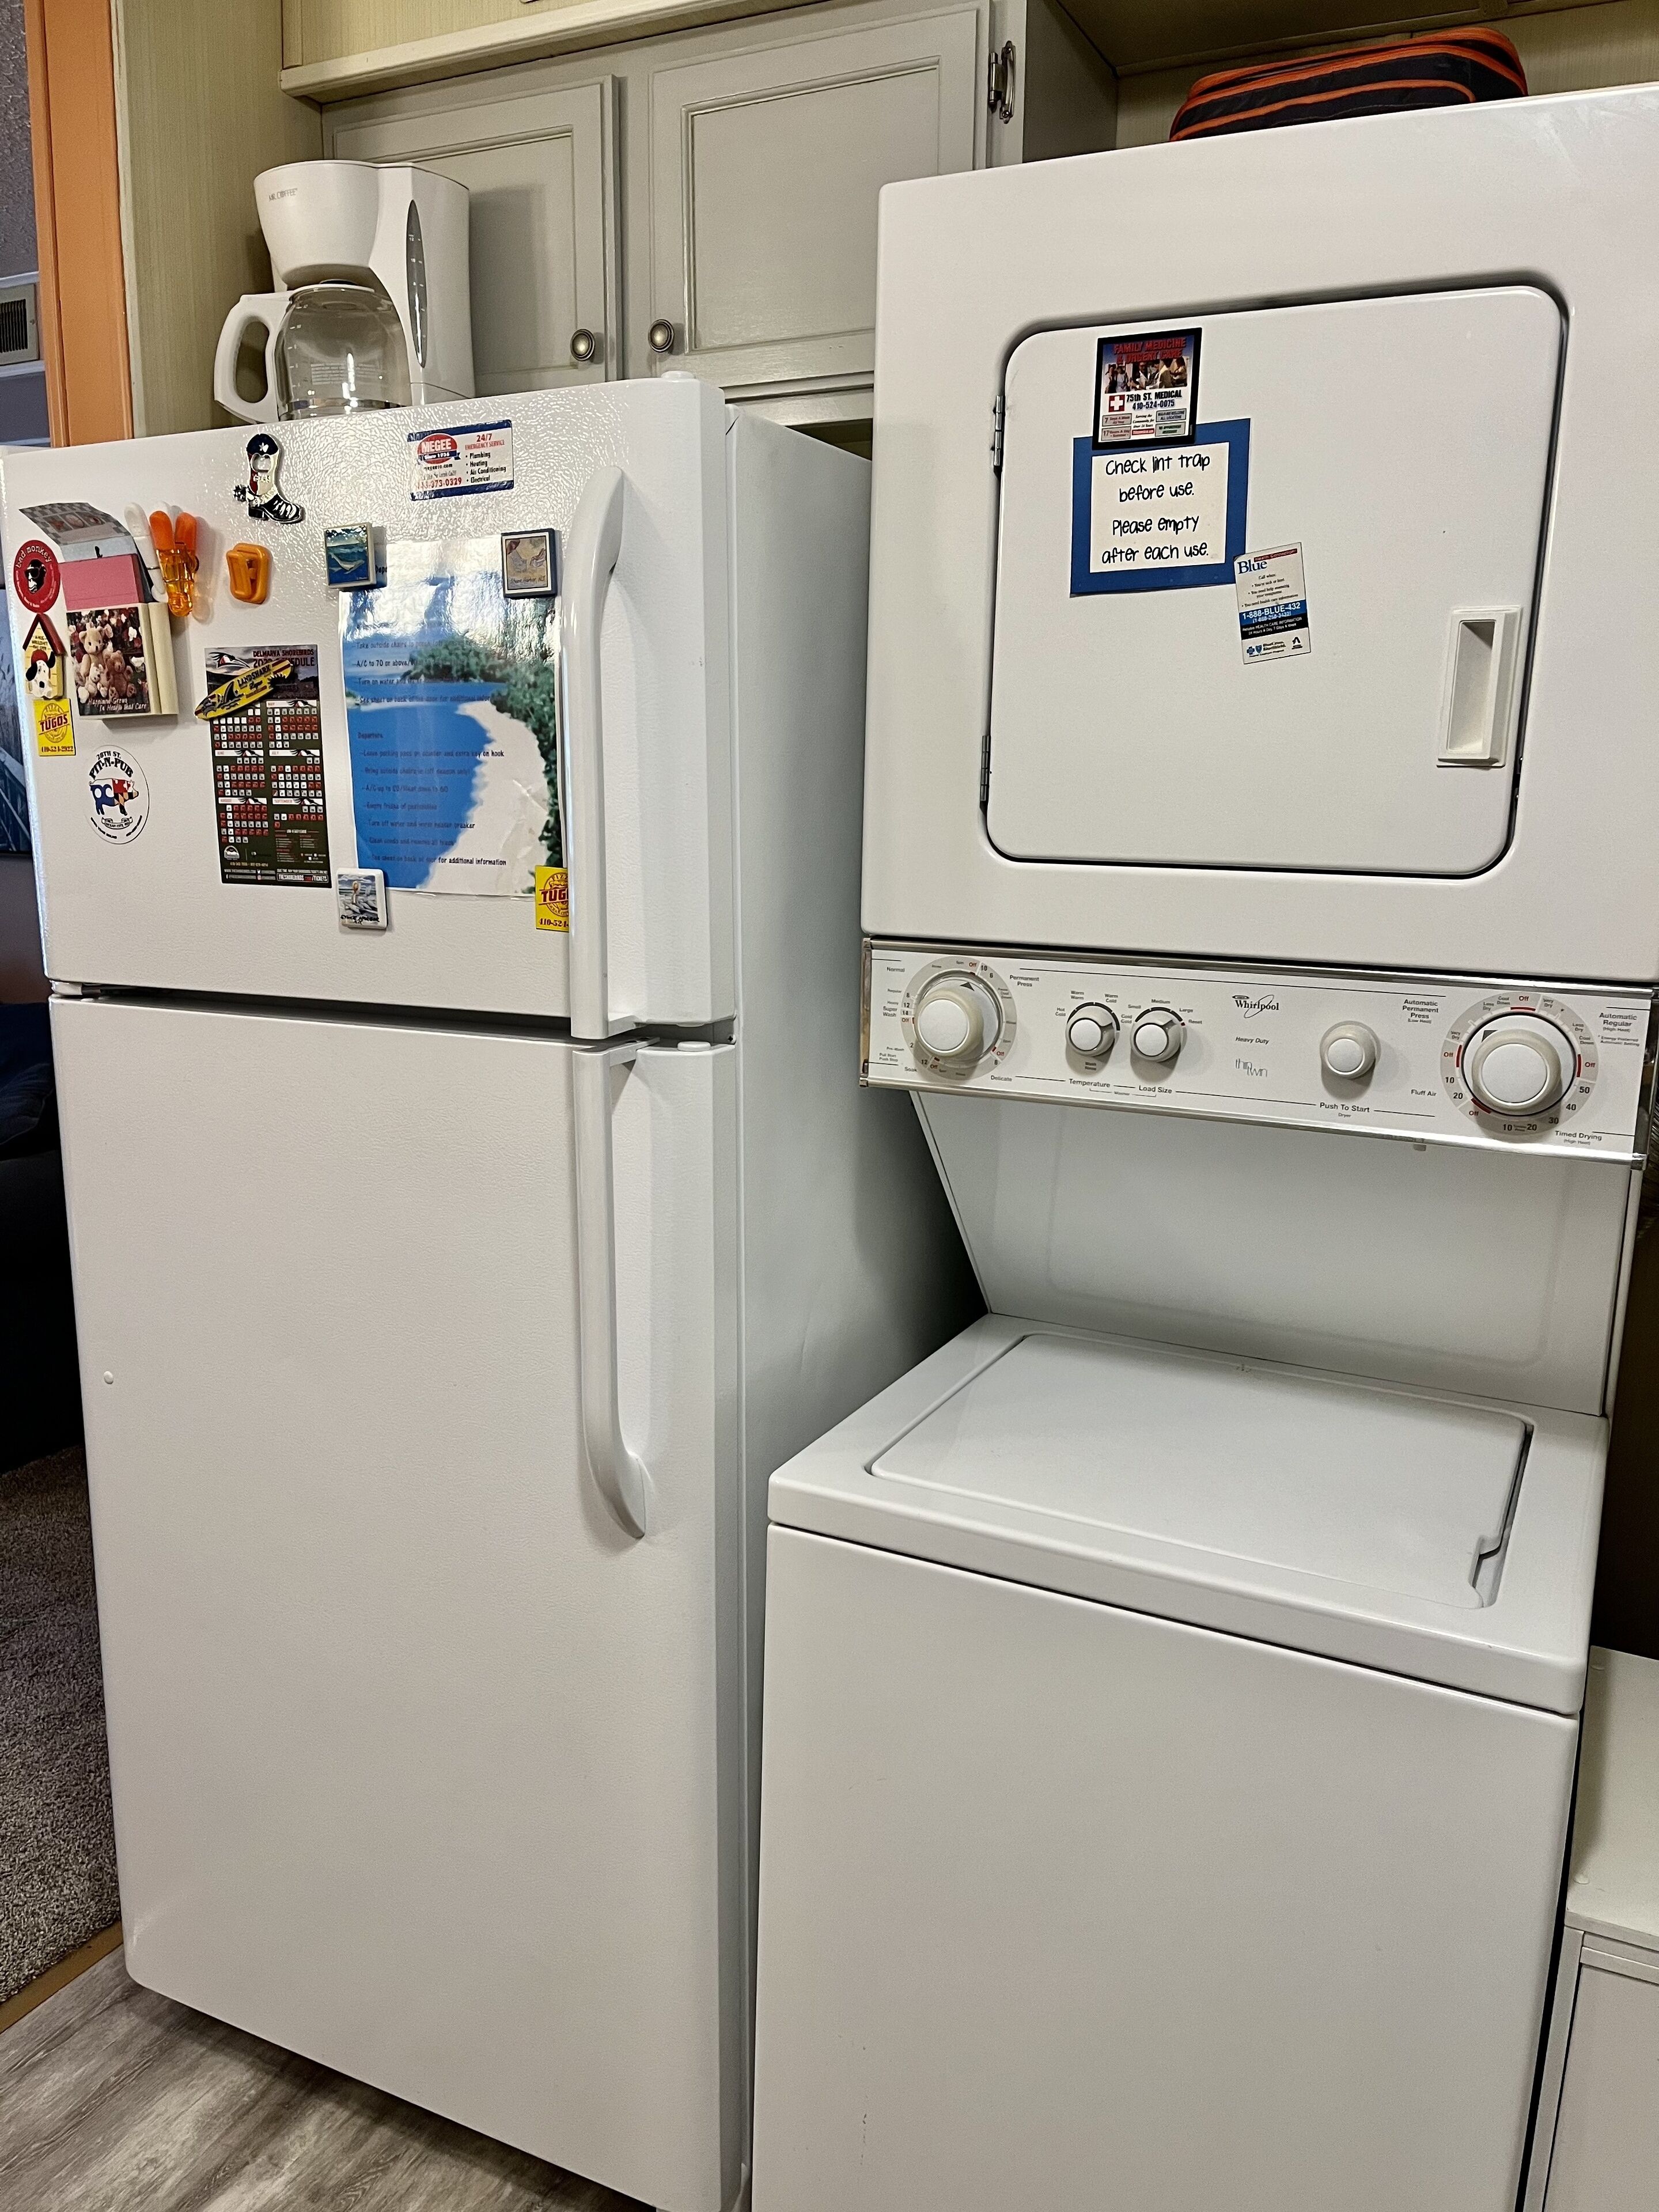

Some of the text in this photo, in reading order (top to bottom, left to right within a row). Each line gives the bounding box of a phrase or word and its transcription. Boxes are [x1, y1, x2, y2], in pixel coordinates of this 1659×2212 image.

[1113, 338, 1187, 355] FAMILY MEDICINE
[1127, 349, 1183, 363] URGENT CARE
[1126, 390, 1182, 403] 75th ST. MEDICAL
[1132, 400, 1175, 410] 410-524-0075
[476, 433, 493, 442] 24/7
[422, 438, 452, 453] MEGEE
[469, 452, 491, 460] Plumbing
[1105, 453, 1210, 475] Check lint trap
[478, 466, 506, 475] Conditioning
[1119, 482, 1194, 502] before use.
[1112, 516, 1199, 536] Please empty
[26, 546, 52, 563] monkey
[1102, 542, 1209, 564] after each use.
[1237, 559, 1267, 574] Blue
[1243, 602, 1301, 620] 1-888-BLUE-432
[391, 641, 407, 649] chairs
[282, 649, 314, 657] SHOREBIRDS
[376, 659, 384, 667] 70
[237, 664, 271, 687] LANDSHARK
[40, 714, 68, 732] TUGOS
[96, 751, 121, 760] 28TH ST.
[89, 757, 134, 780] PIT-N-PUB
[1235, 999, 1279, 1011] Whirlpool
[1402, 1005, 1438, 1013] Permanent
[1599, 1012, 1638, 1020] Automatic
[1603, 1019, 1633, 1027] Regular
[1069, 1078, 1111, 1088] Temperature
[1320, 1102, 1338, 1110] Push
[1351, 1105, 1370, 1113] Start
[1579, 1132, 1602, 1141] Drying
